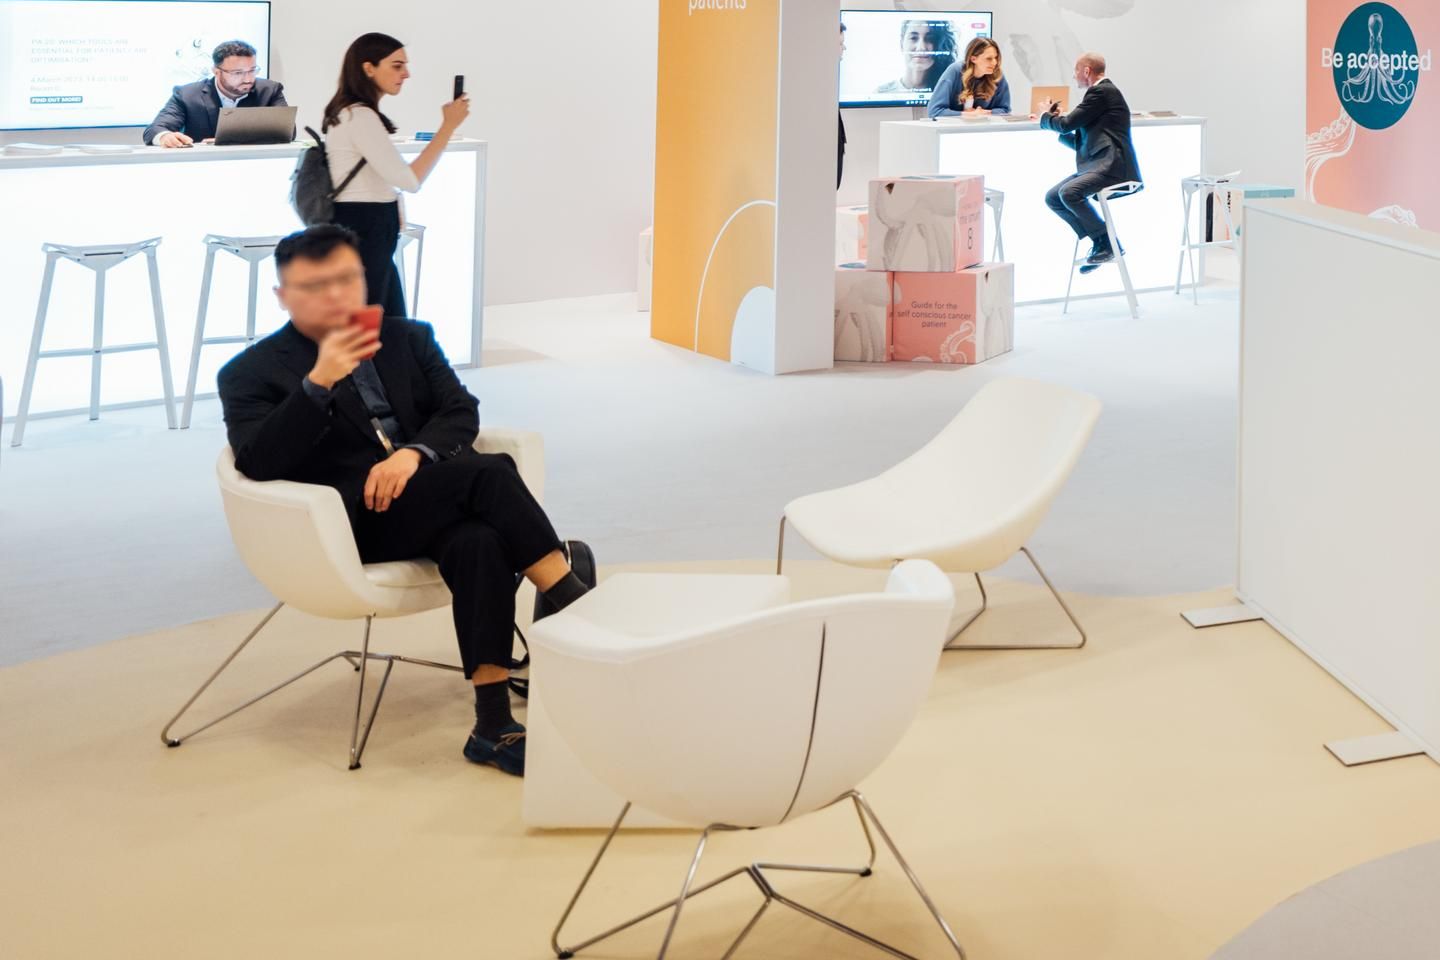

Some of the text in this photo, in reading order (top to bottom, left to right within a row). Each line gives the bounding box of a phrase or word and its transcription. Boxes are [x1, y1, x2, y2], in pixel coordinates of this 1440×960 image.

[1321, 47, 1431, 75] Be accepted
[911, 300, 958, 310] Guide for the
[897, 311, 972, 320] self conscious cancer
[921, 320, 947, 329] patient
